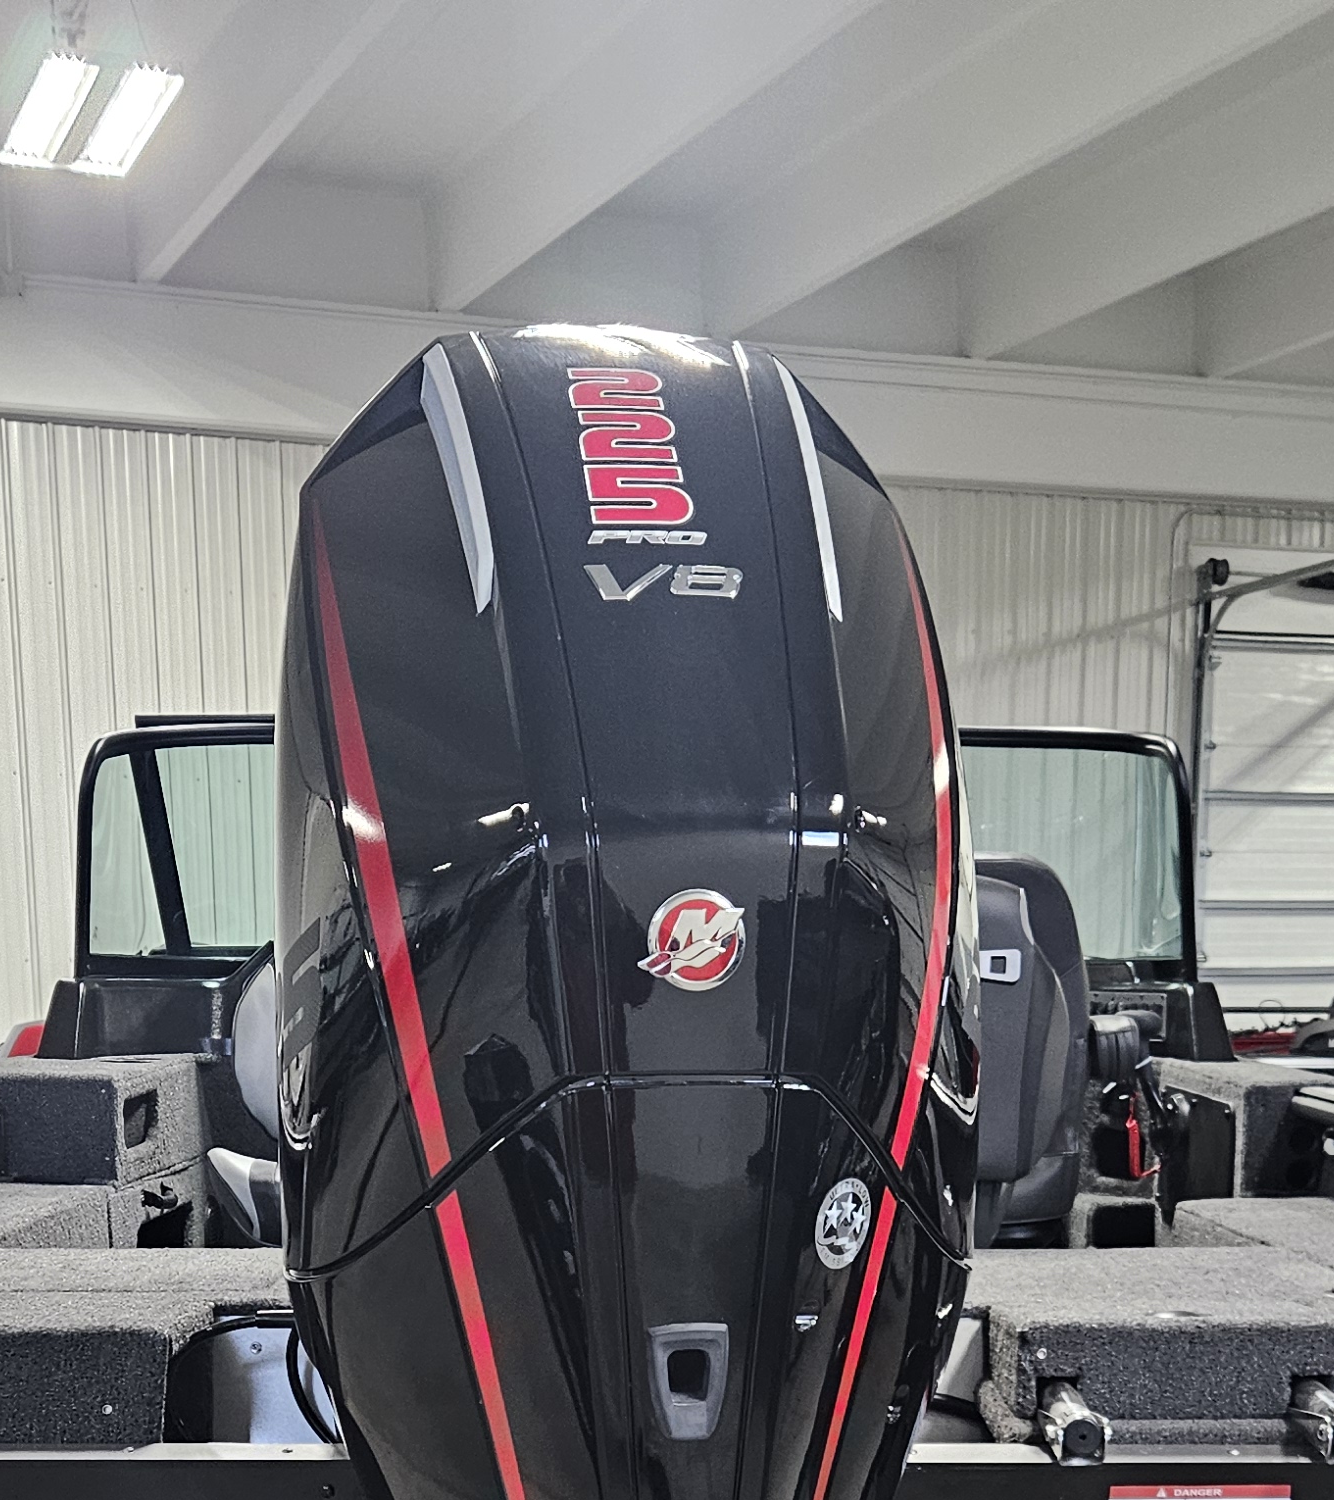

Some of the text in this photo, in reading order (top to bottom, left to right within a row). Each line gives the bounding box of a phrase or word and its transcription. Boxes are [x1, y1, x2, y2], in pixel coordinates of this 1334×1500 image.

[567, 367, 694, 525] 225
[587, 529, 708, 546] PRO
[583, 563, 744, 601] V8
[1173, 1488, 1223, 1497] DANGER
